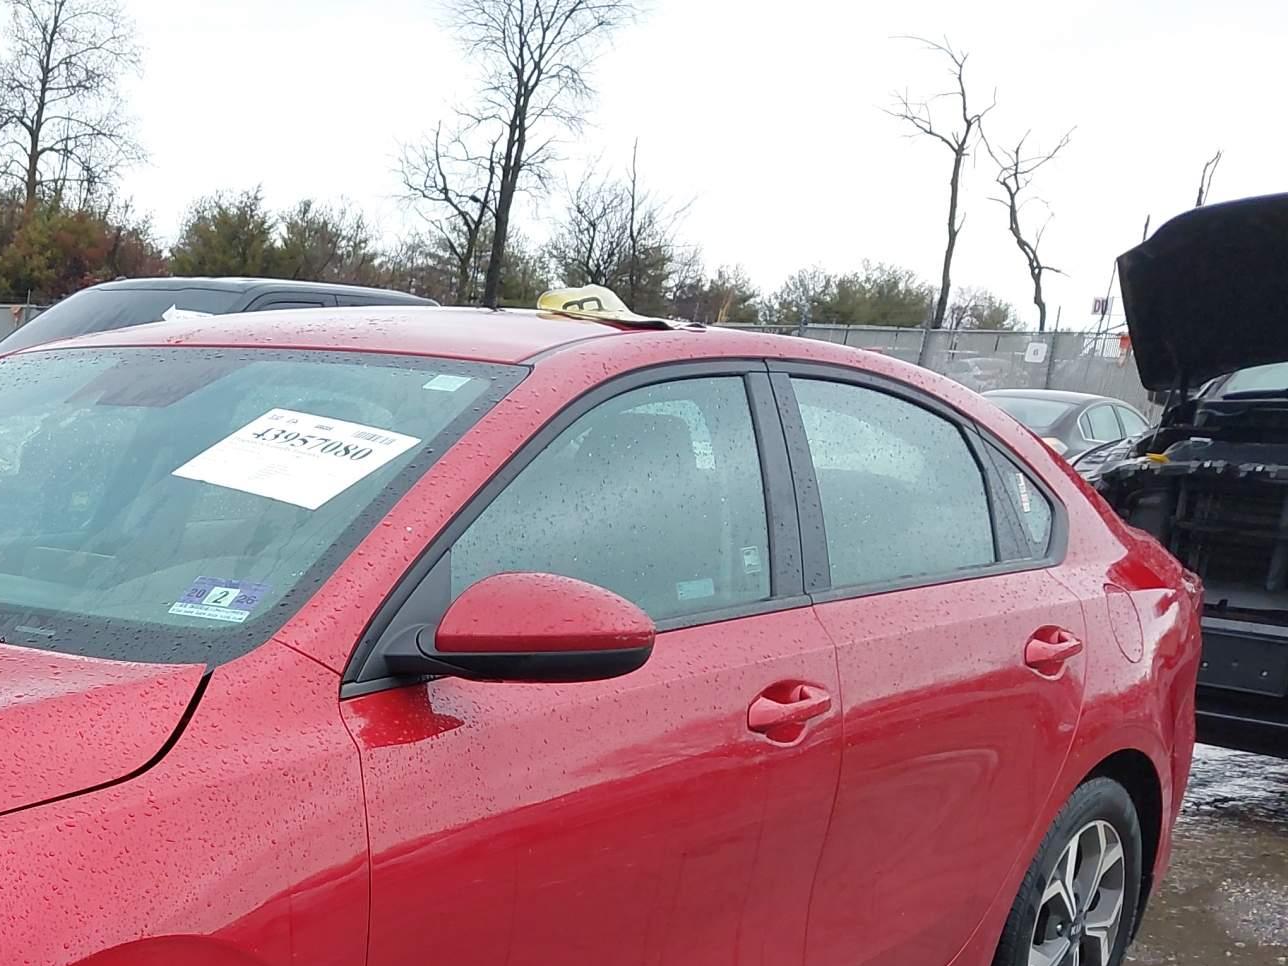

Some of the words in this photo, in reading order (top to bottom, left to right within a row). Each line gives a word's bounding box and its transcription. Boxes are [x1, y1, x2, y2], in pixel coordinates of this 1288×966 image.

[252, 427, 374, 461] 43957080
[187, 588, 207, 599] 20
[213, 590, 230, 604] 2
